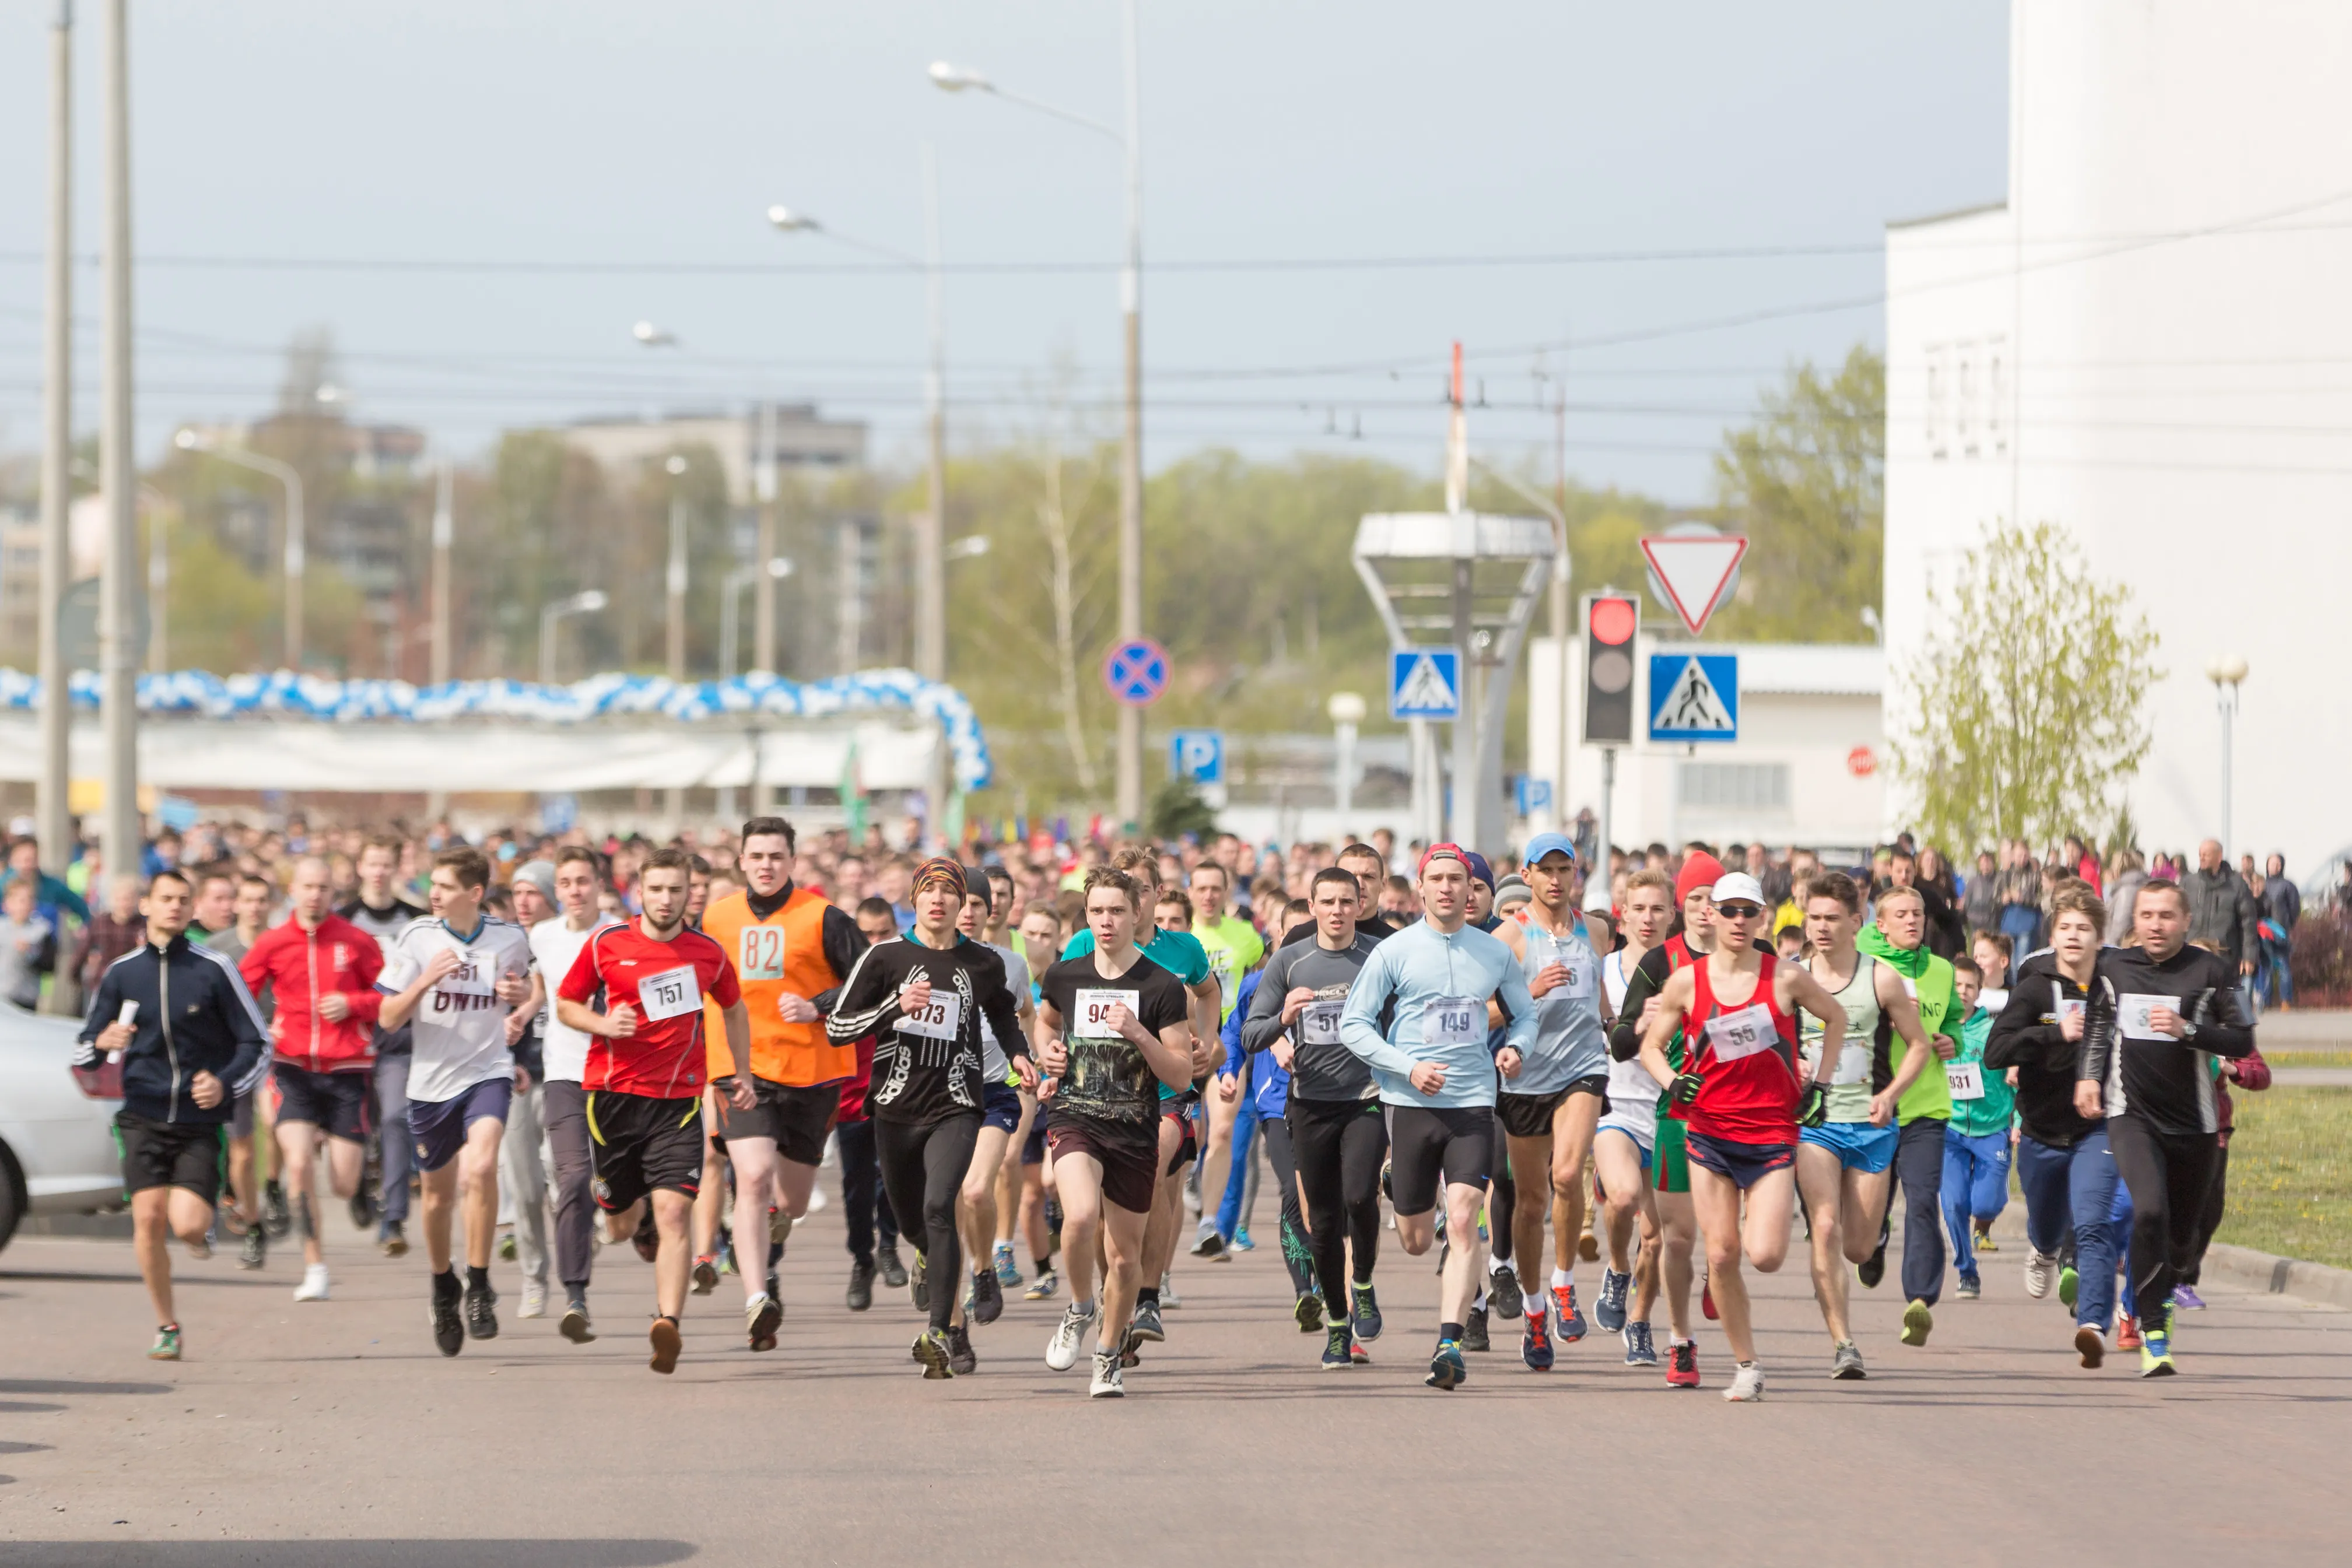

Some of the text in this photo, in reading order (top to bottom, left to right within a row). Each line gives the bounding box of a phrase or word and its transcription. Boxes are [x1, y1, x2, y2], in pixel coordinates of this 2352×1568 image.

[1182, 735, 1214, 776] P
[746, 930, 778, 971] 82
[654, 983, 682, 1006] 757
[952, 974, 970, 1024] adidas
[1439, 1012, 1470, 1032] 149
[1729, 1024, 1756, 1046] 55
[876, 1046, 912, 1106] adidas
